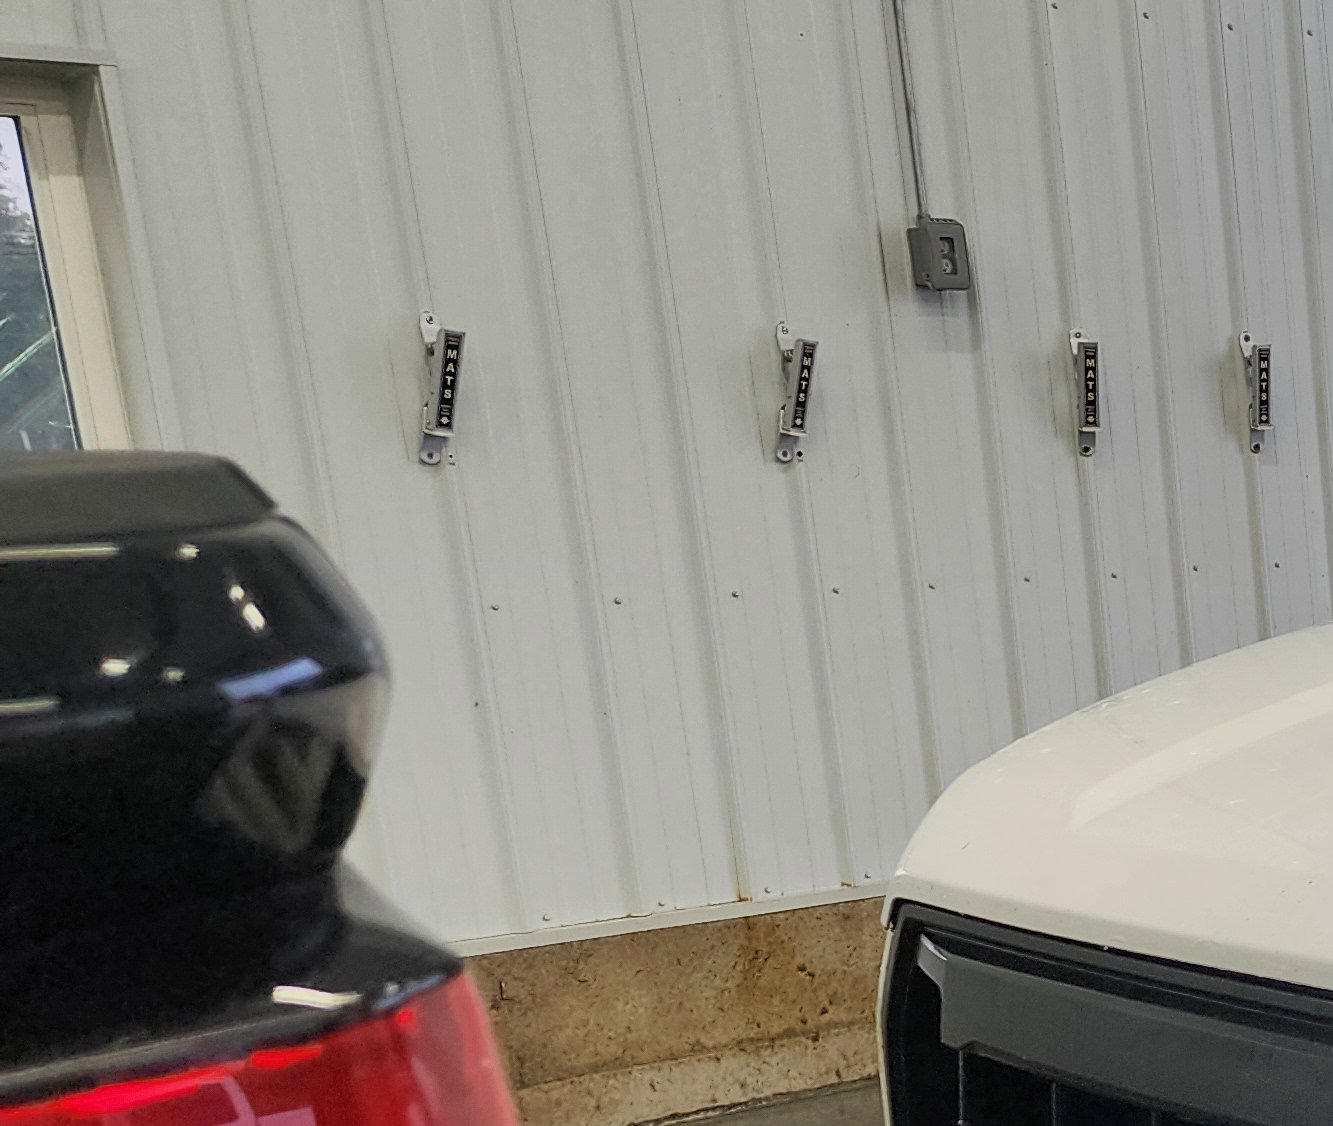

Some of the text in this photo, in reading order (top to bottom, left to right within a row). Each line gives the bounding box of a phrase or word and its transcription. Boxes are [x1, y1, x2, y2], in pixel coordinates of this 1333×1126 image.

[443, 349, 458, 399] MATS
[798, 356, 812, 402] MATS
[1085, 358, 1096, 401] MATS
[1260, 360, 1268, 401] MATS
